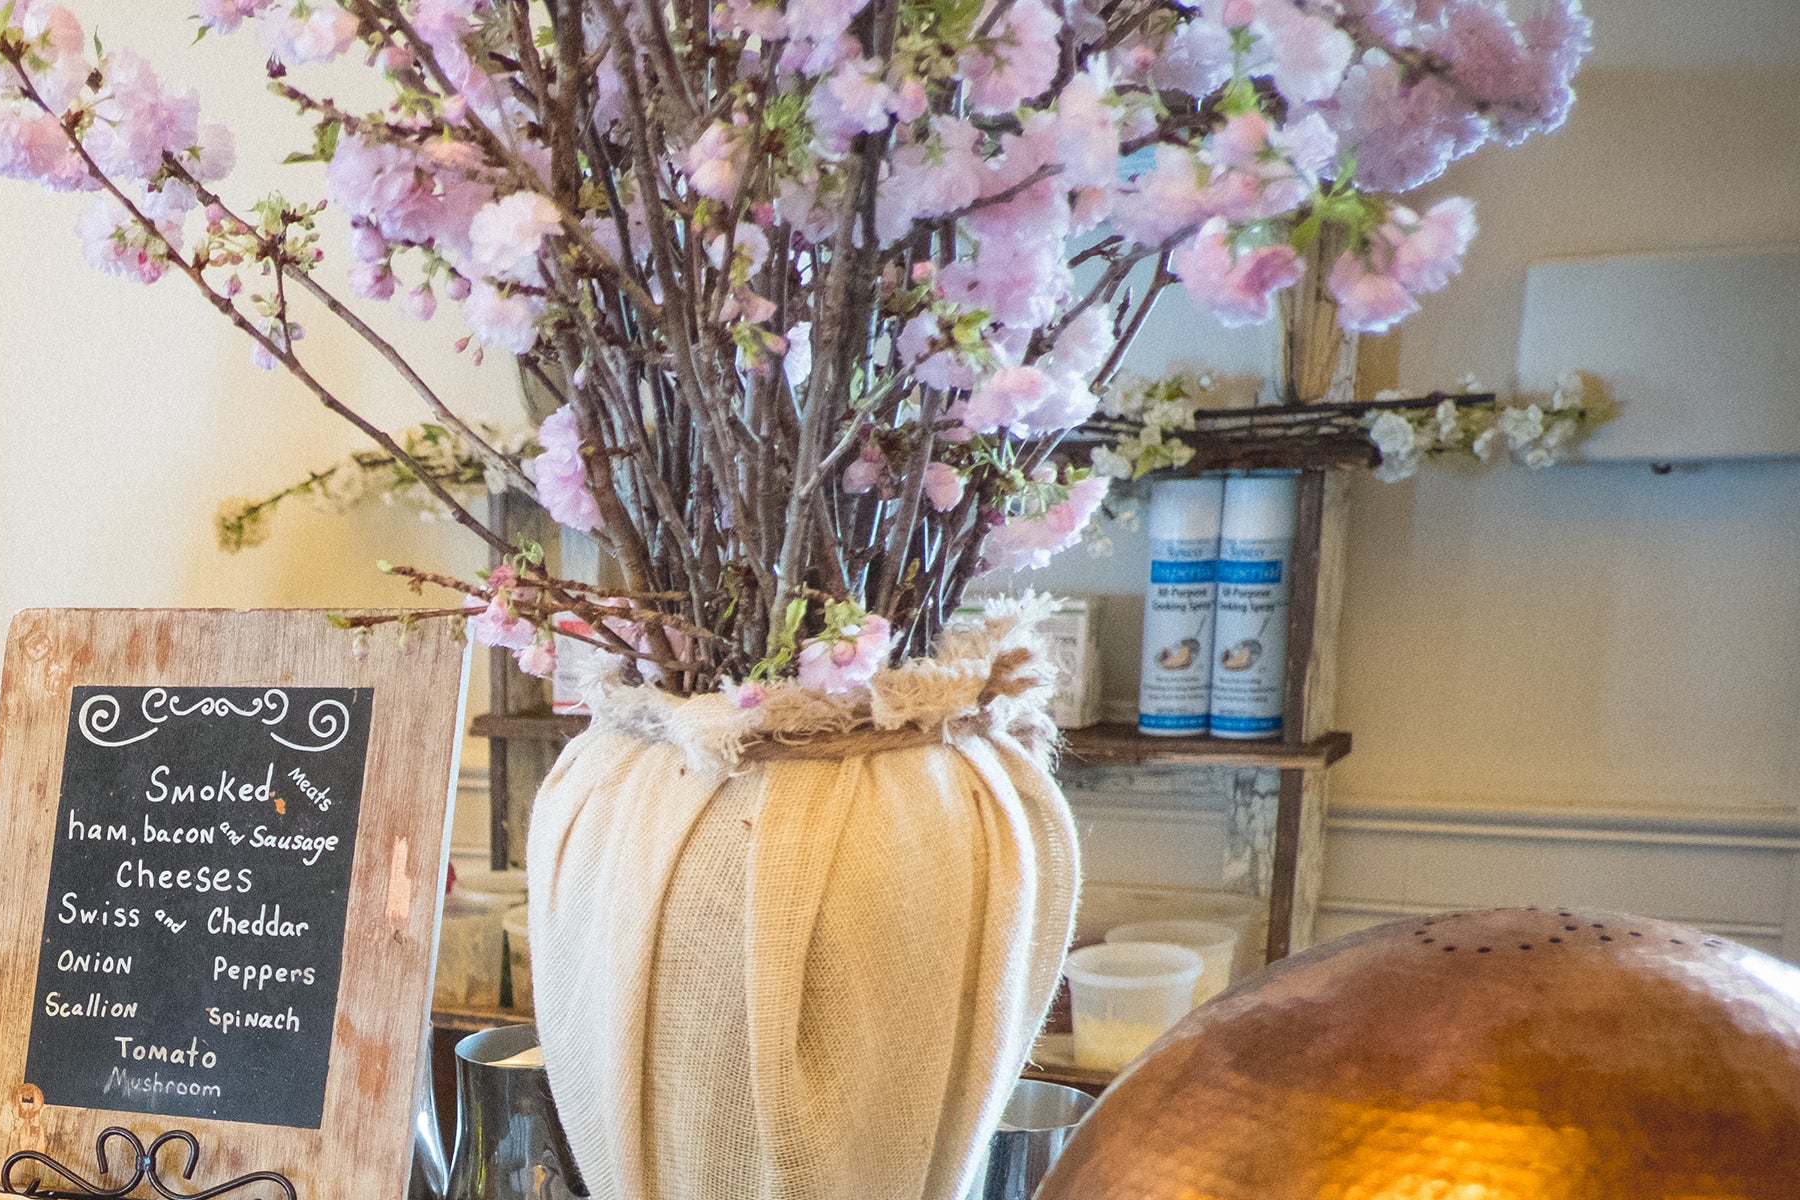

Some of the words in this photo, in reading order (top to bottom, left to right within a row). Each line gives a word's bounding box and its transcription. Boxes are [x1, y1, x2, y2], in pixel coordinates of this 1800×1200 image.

[145, 762, 274, 805] Smoked
[287, 767, 333, 812] Meats
[143, 813, 215, 845] bacon
[219, 821, 246, 846] and
[249, 824, 340, 866] Sausage
[116, 858, 253, 893] Cheeses
[57, 891, 141, 928] Swiss
[153, 908, 188, 934] and
[206, 903, 310, 938] Cheddar
[212, 955, 316, 991] Peppers
[44, 991, 139, 1019] Scallion
[114, 1036, 218, 1069] Tomato
[102, 1065, 222, 1098] Mushroom
